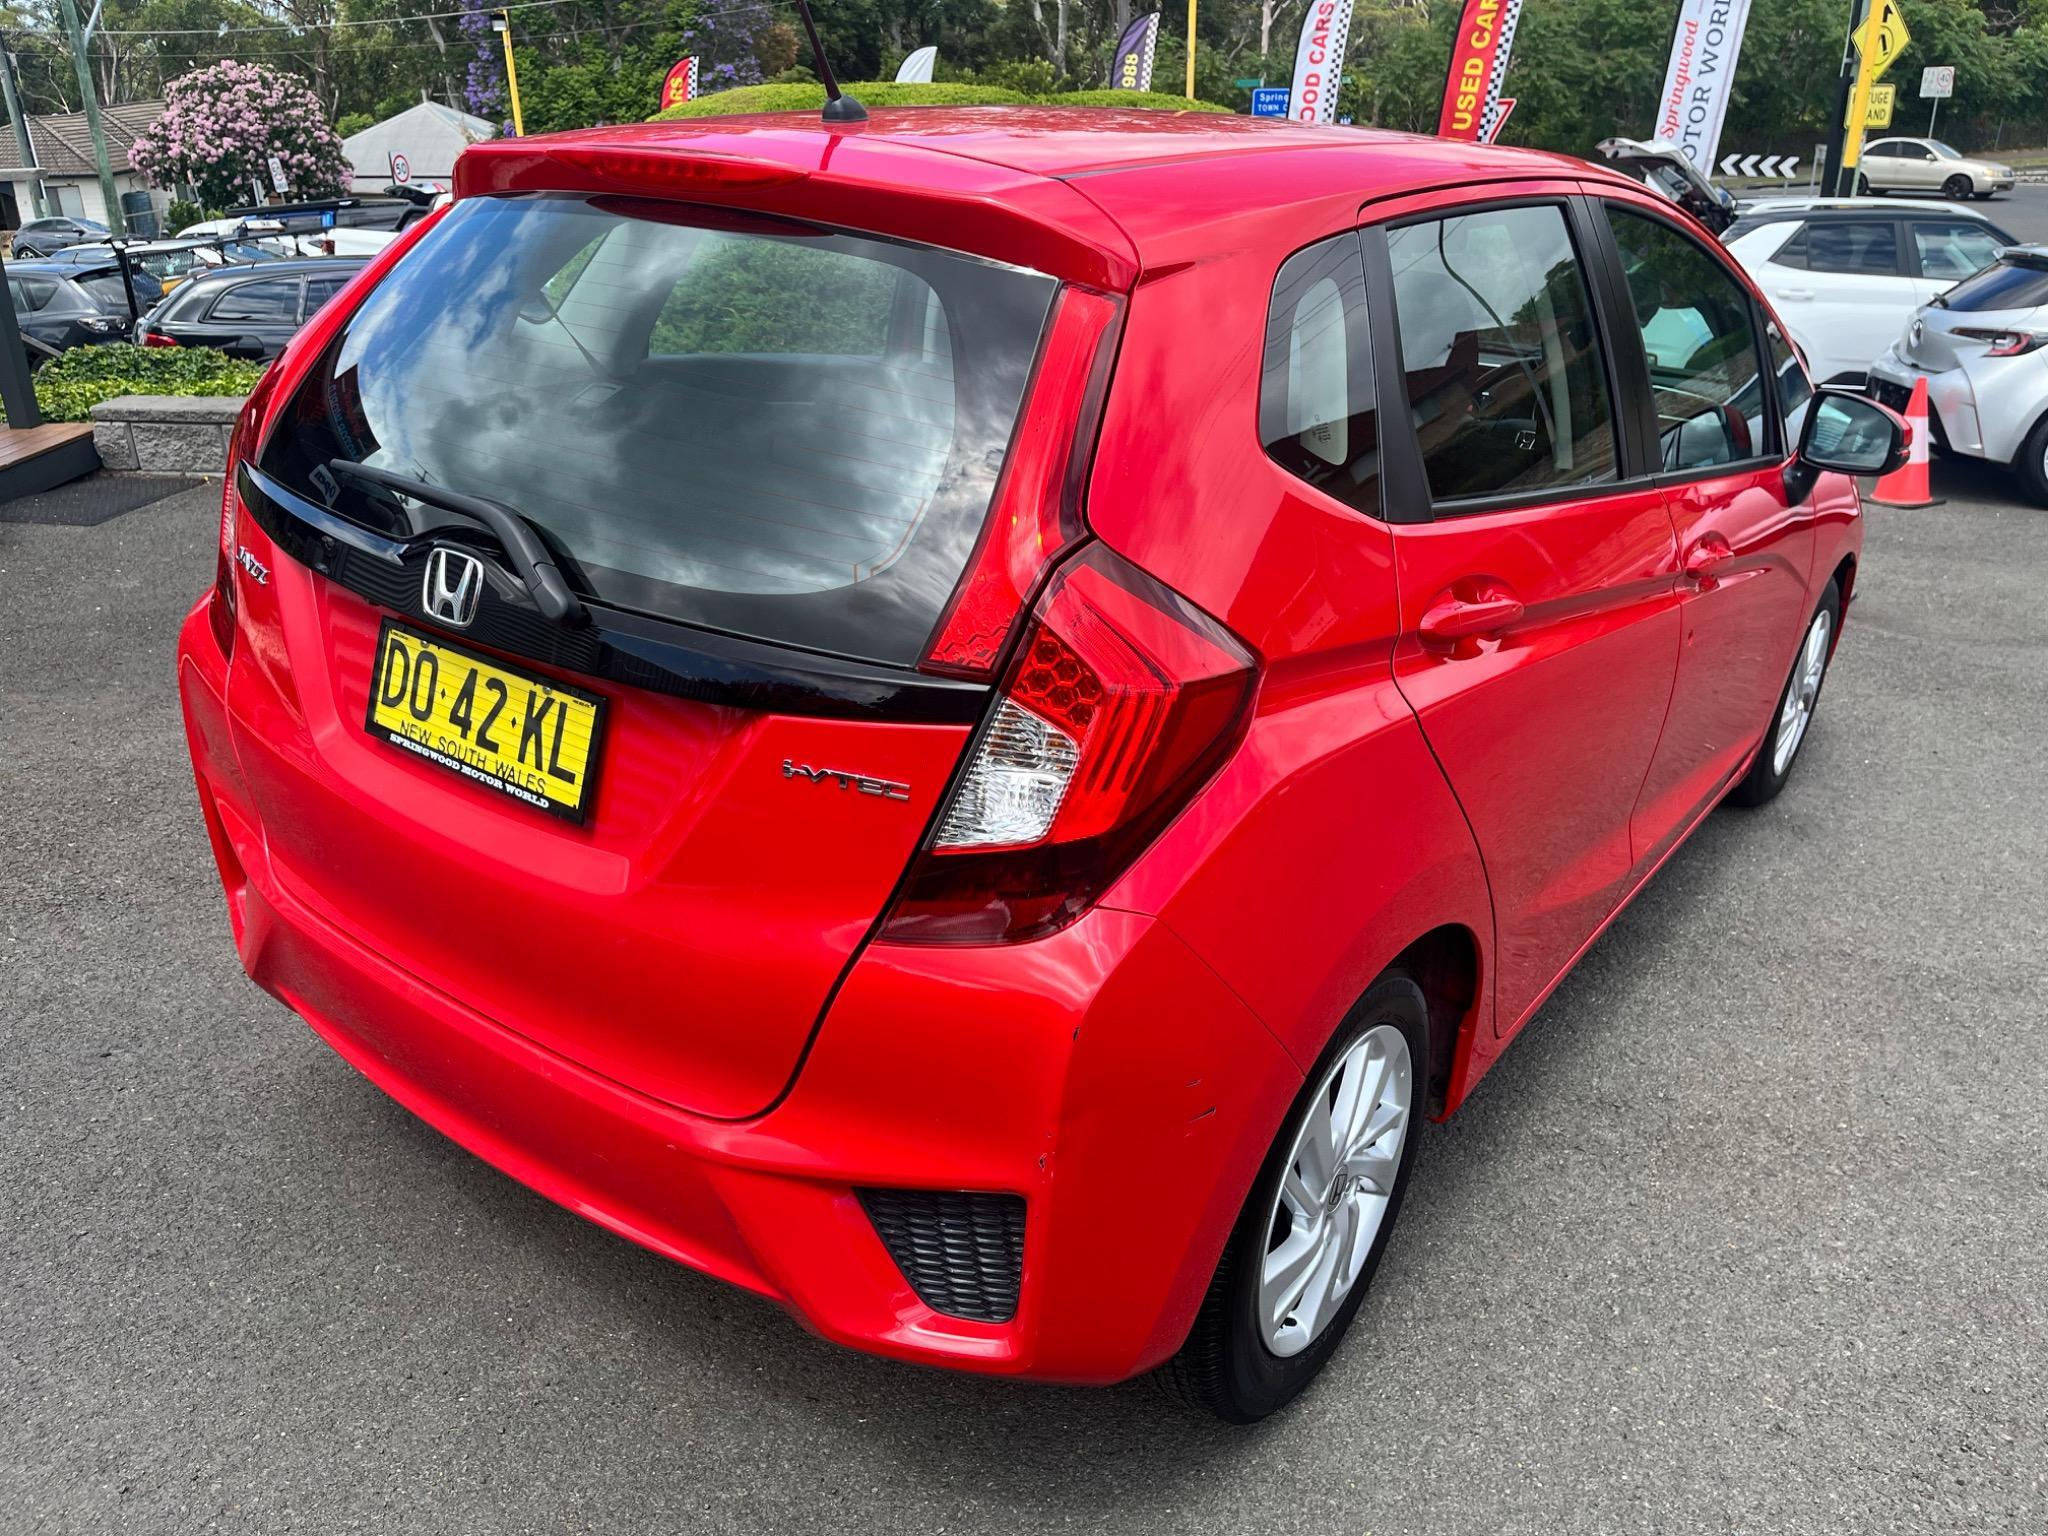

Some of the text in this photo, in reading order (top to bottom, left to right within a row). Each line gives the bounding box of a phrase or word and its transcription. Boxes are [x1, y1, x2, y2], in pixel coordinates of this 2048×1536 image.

[1308, 2, 1335, 64] CARS
[669, 77, 684, 107] RS
[1257, 104, 1279, 112] TOWN
[1452, 57, 1484, 130] USED
[1660, 20, 1698, 139] Springwood
[395, 162, 407, 176] 50
[389, 733, 549, 809] SPRINGWOOD MOTOR WORLD
[400, 718, 546, 794] NEW SOUTH WALES
